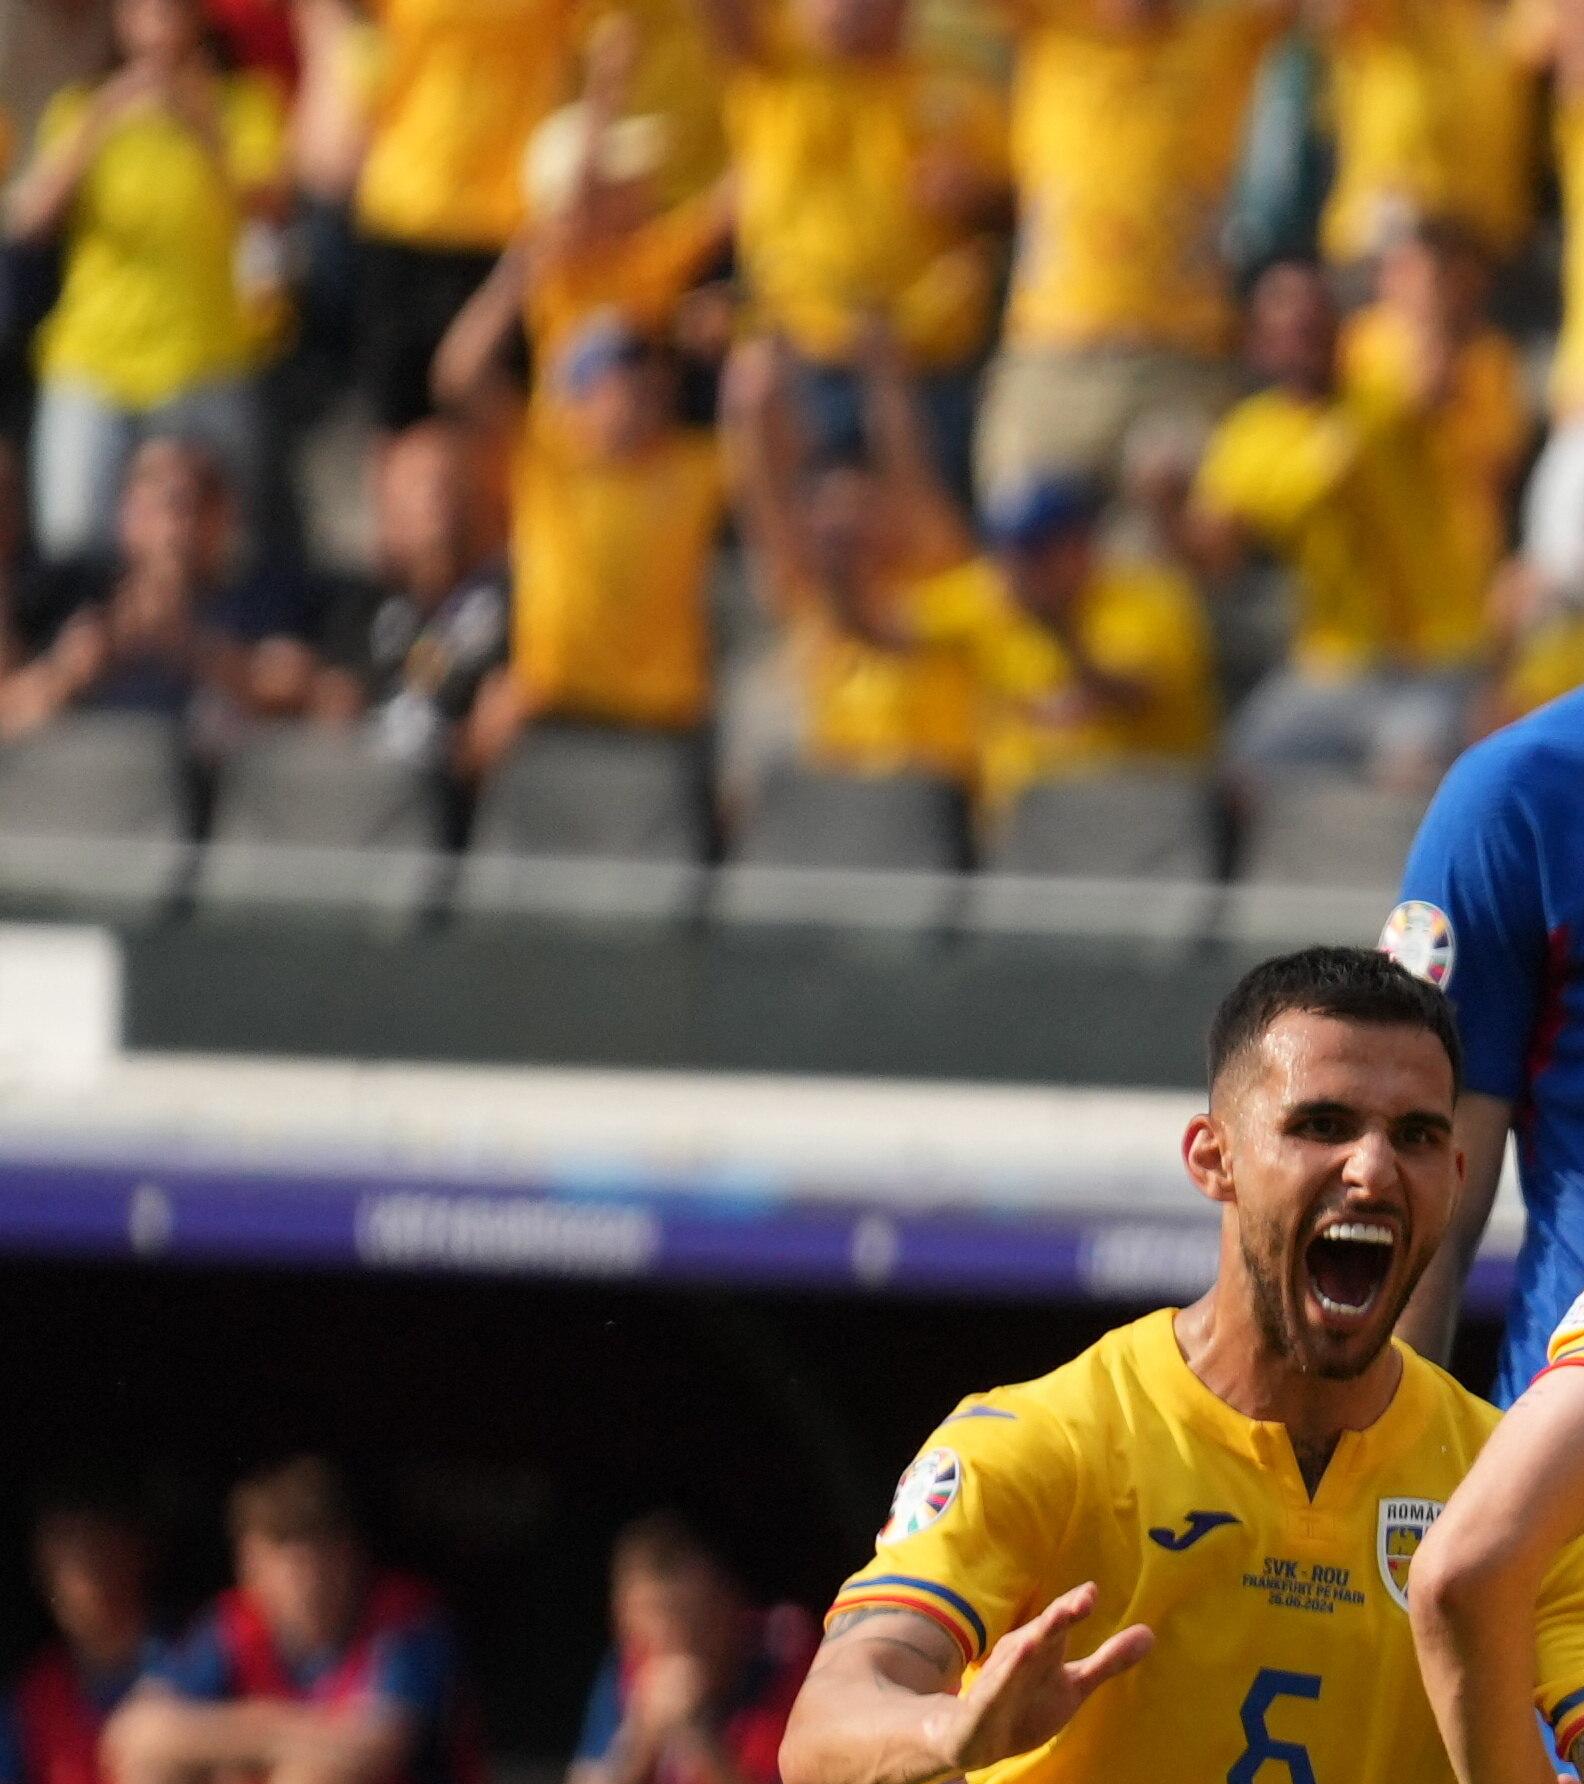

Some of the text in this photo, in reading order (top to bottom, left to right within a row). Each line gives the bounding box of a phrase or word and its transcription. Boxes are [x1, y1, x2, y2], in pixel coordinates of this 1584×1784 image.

[1263, 1556, 1297, 1579] SVK
[1311, 1564, 1350, 1587] ROU
[1242, 1573, 1312, 1597] FRANKFURT
[1332, 1587, 1365, 1605] MAIN
